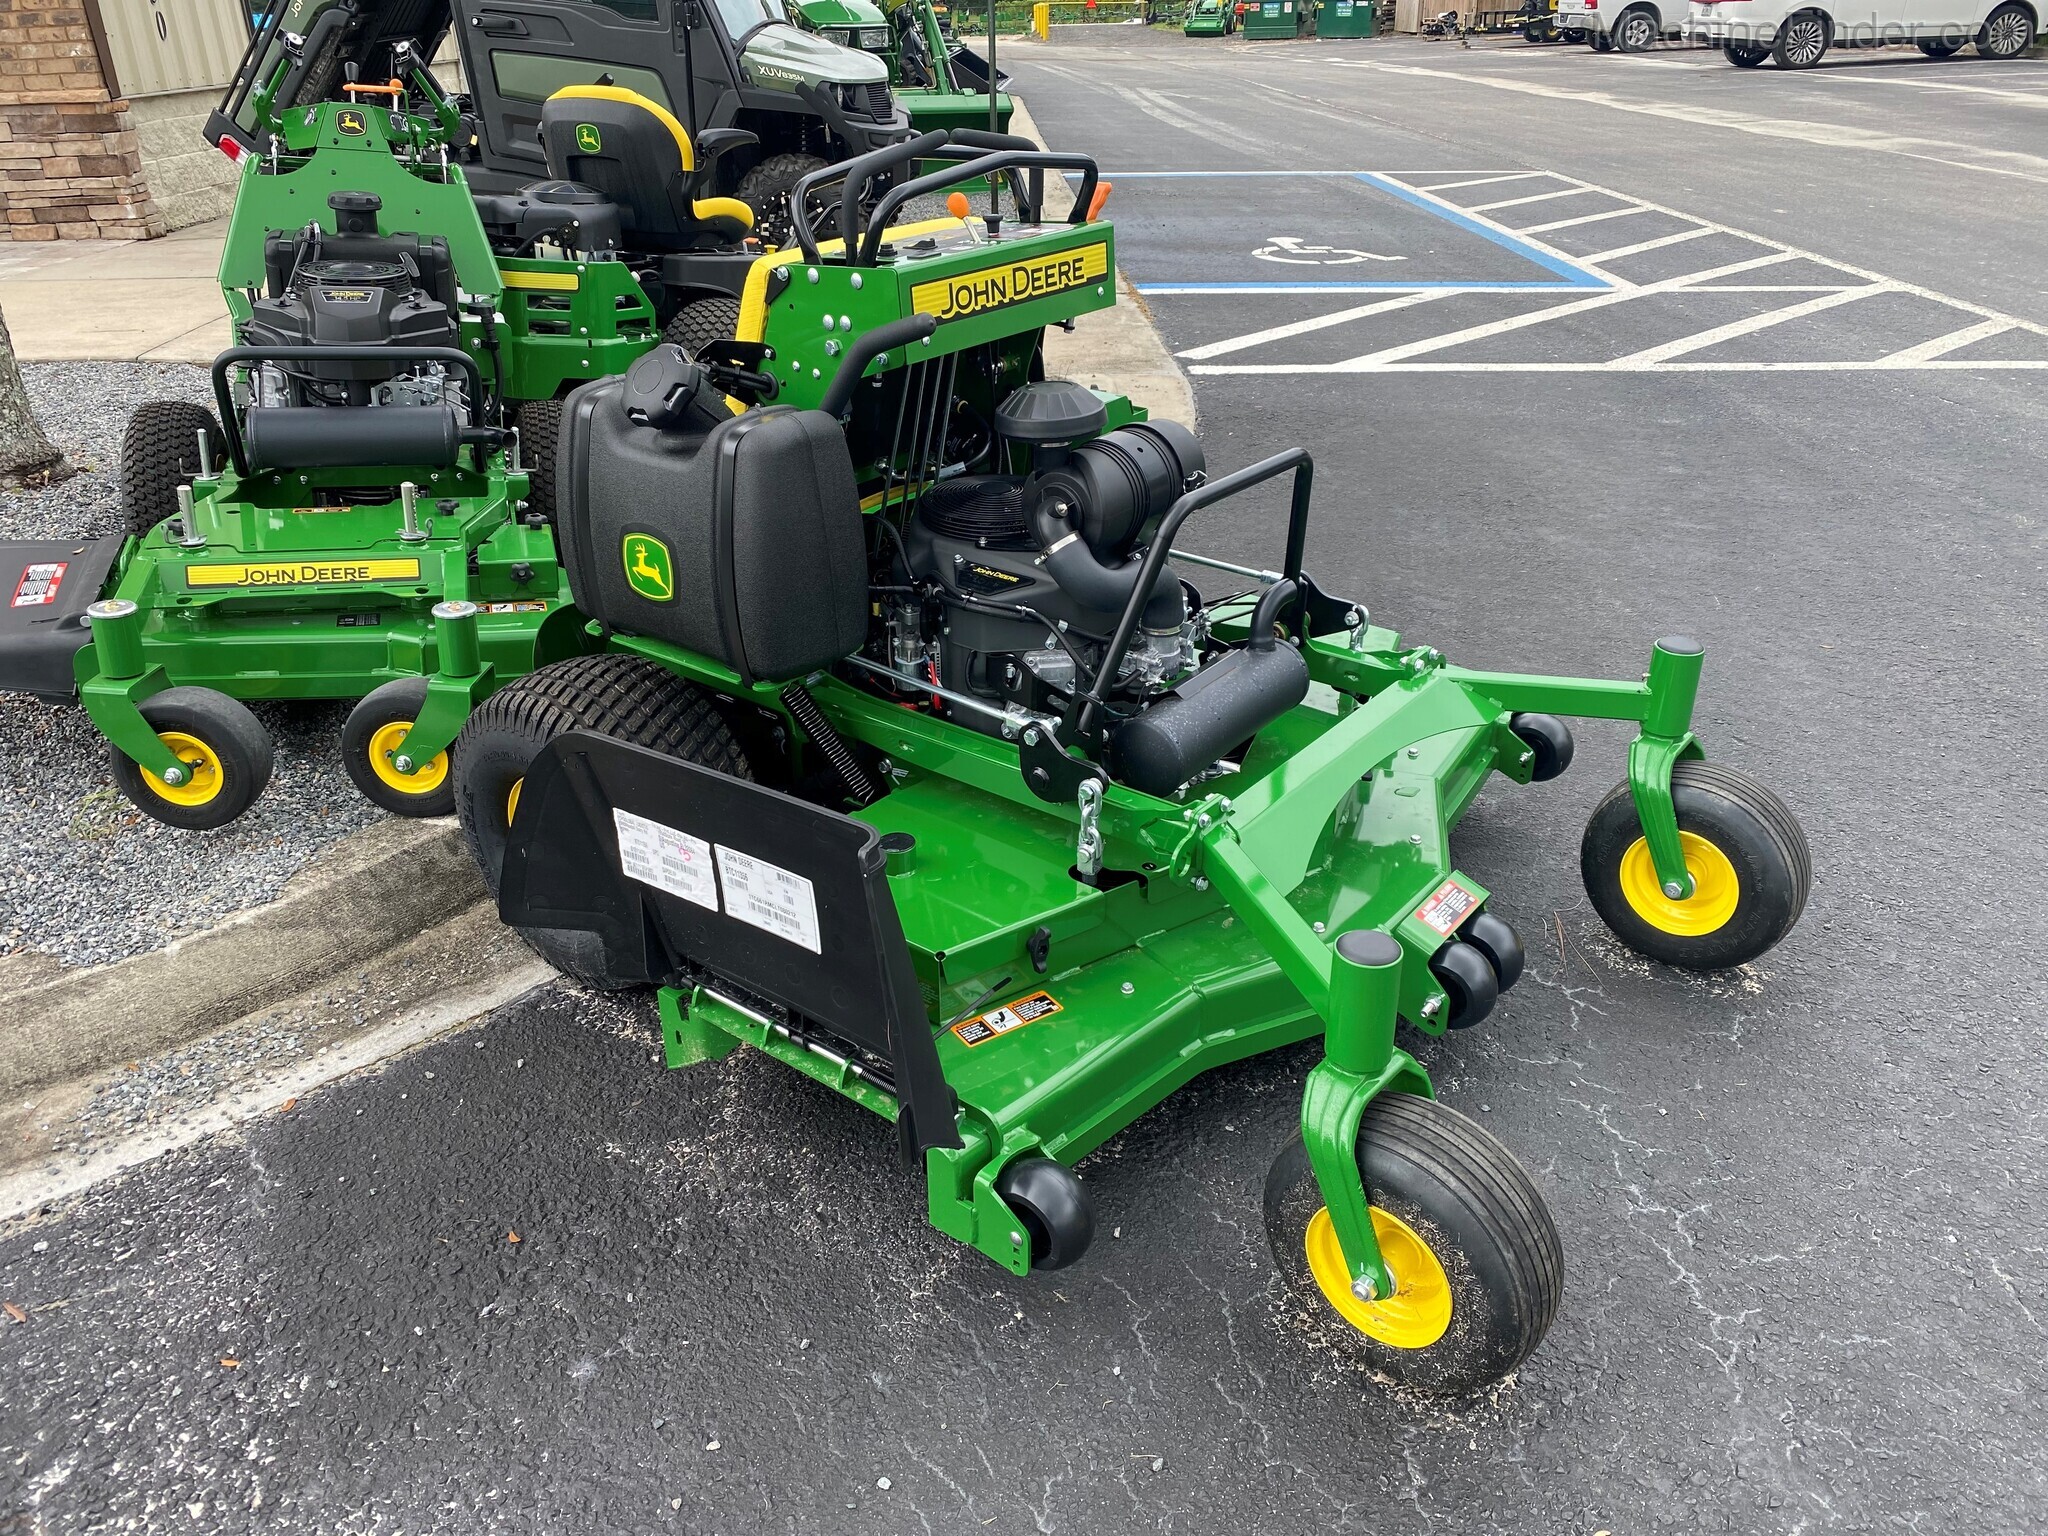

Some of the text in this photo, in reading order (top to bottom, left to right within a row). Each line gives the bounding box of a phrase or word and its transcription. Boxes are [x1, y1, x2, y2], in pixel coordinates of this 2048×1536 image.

[941, 256, 1085, 316] JOHN DEERE
[237, 565, 370, 584] JOHN DEERE
[972, 566, 1019, 583] JOHN DEERE
